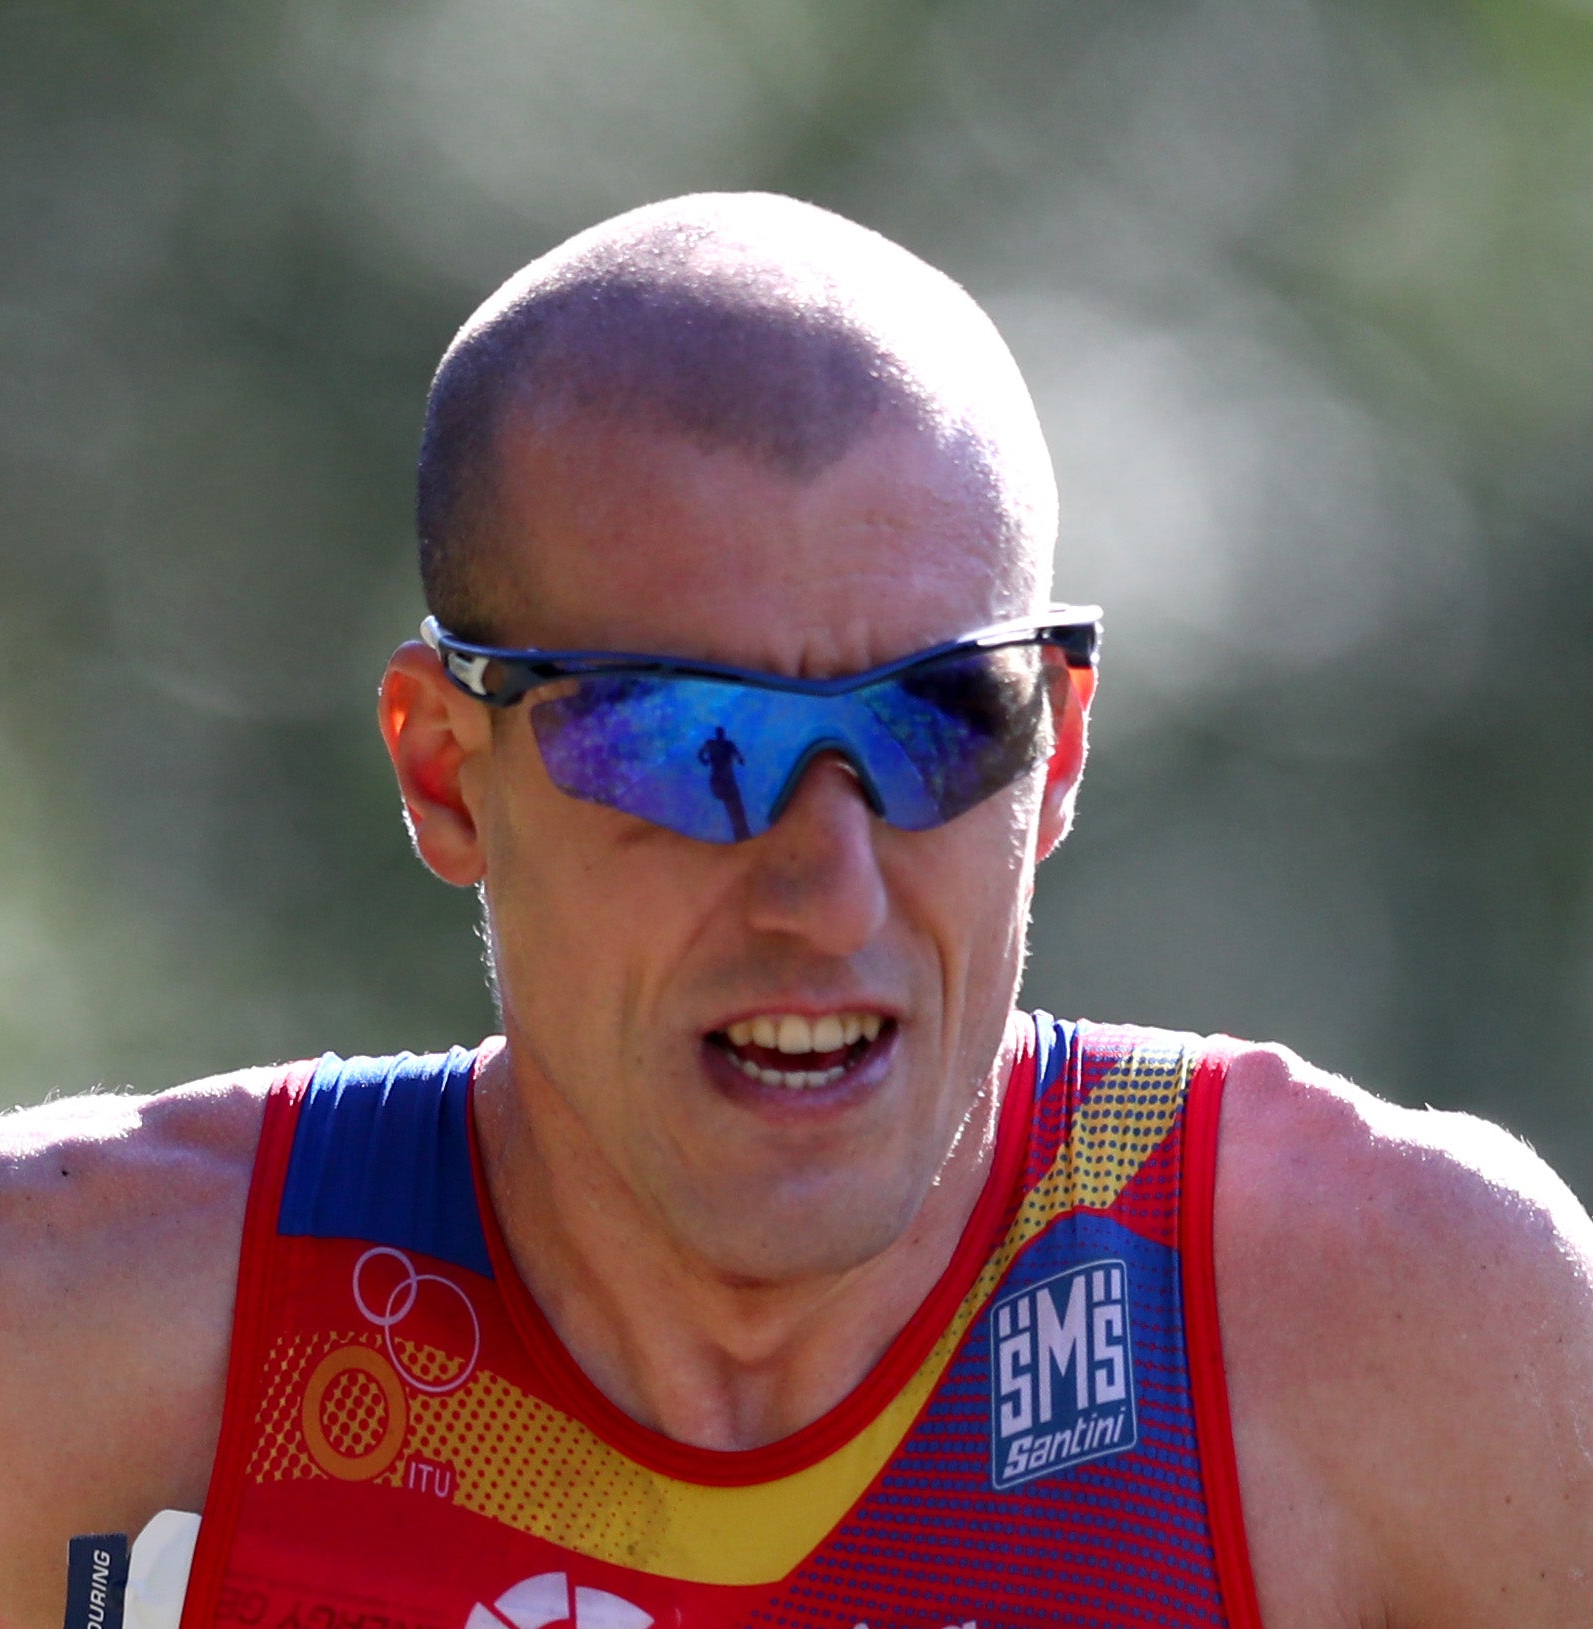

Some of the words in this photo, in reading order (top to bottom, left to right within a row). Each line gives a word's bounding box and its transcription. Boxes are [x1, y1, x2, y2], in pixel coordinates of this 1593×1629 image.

[998, 1268, 1127, 1438] SMS
[408, 1461, 451, 1498] ITU
[1002, 1406, 1128, 1481] Santini
